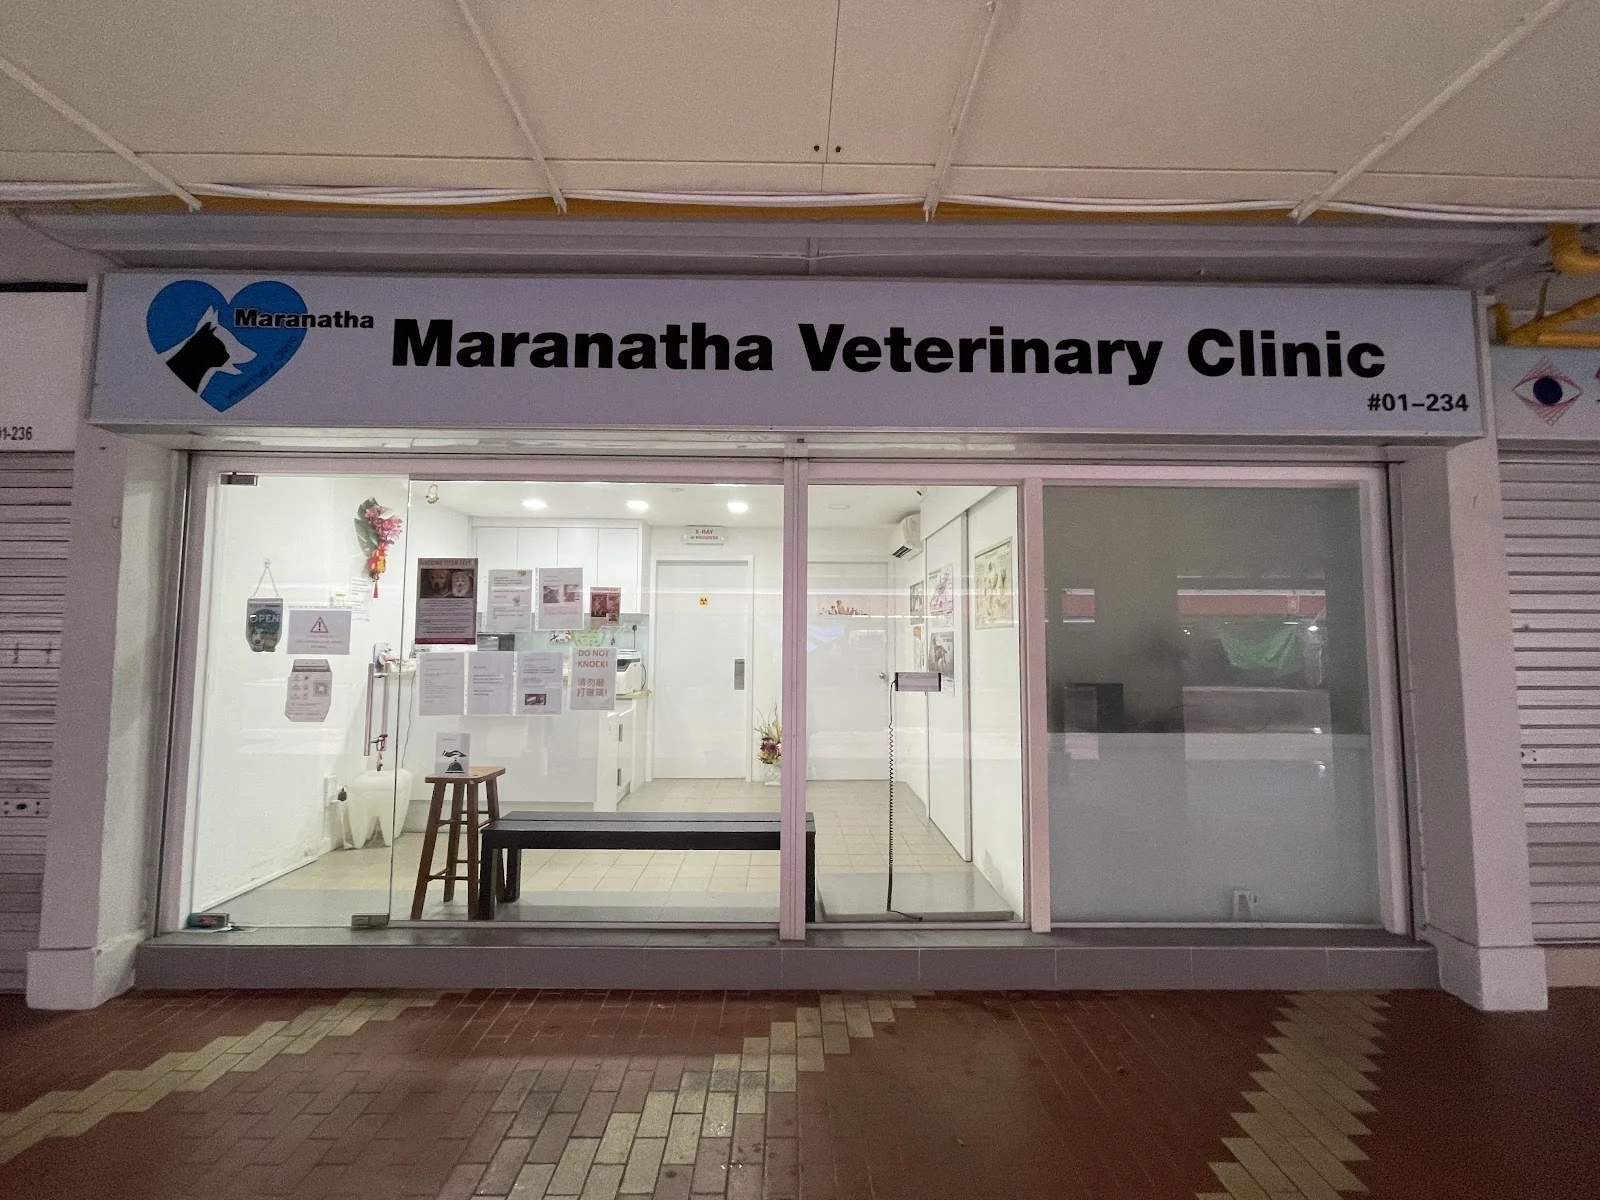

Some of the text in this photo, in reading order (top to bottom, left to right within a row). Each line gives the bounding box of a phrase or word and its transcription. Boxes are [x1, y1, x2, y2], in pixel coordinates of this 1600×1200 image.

[234, 308, 375, 329] Maranatha
[392, 318, 1386, 386] Maranatha Veterinary Clinic
[1367, 393, 1470, 412] #01-234
[0, 426, 33, 441] 1-236
[249, 613, 280, 623] OPEN
